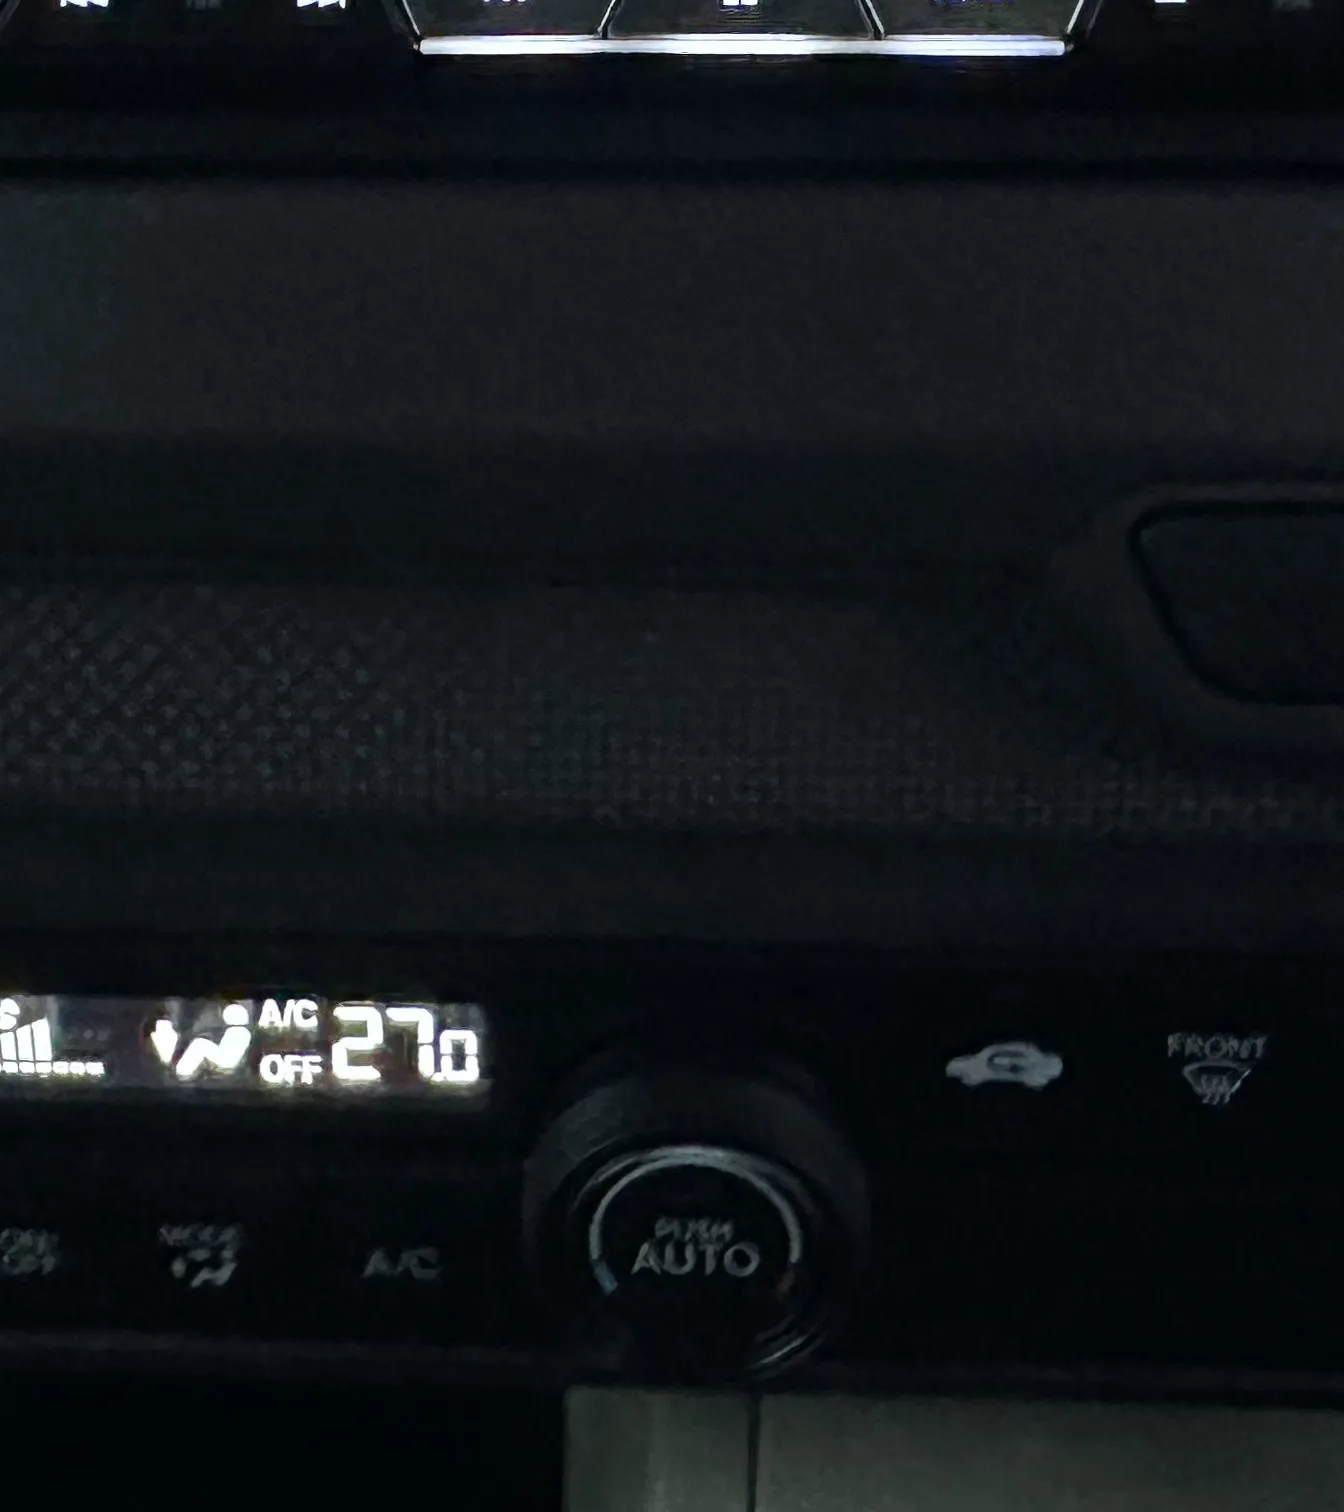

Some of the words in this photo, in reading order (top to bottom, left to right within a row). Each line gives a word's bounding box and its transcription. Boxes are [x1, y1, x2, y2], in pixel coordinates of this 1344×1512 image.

[258, 998, 319, 1031] A/C
[1167, 1032, 1268, 1058] FRONT
[259, 1053, 324, 1087] OFF
[629, 1240, 761, 1278] AUTO
